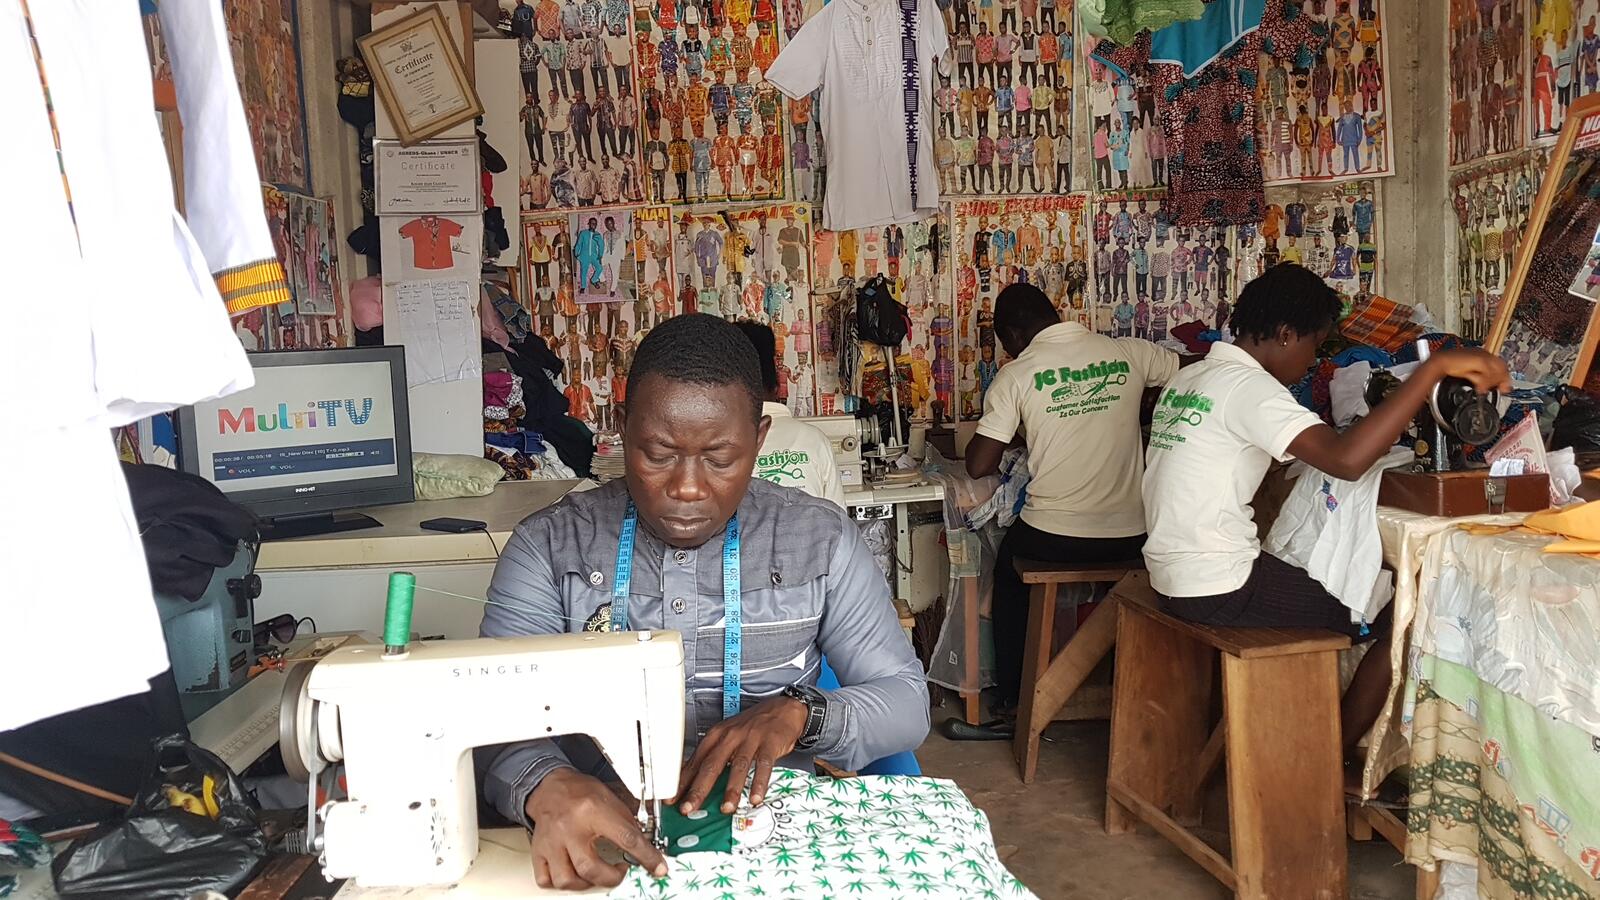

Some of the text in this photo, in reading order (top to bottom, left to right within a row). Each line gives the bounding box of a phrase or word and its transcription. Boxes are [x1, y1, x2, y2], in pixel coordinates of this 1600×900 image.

[401, 161, 456, 170] Certificate
[1033, 360, 1130, 391] JC Fashion
[1046, 394, 1121, 413] Customer Satisfaction
[1068, 409, 1080, 417] Our
[1081, 404, 1109, 414] Concern
[218, 398, 373, 435] MultiTV
[729, 548, 738, 560] 31
[730, 567, 738, 581] 30
[730, 588, 738, 602] 29
[730, 610, 739, 623] 28
[731, 631, 739, 645] 27
[730, 652, 738, 666] 26
[452, 663, 538, 678] SINGER
[729, 674, 738, 687] 25
[729, 694, 737, 708] 24
